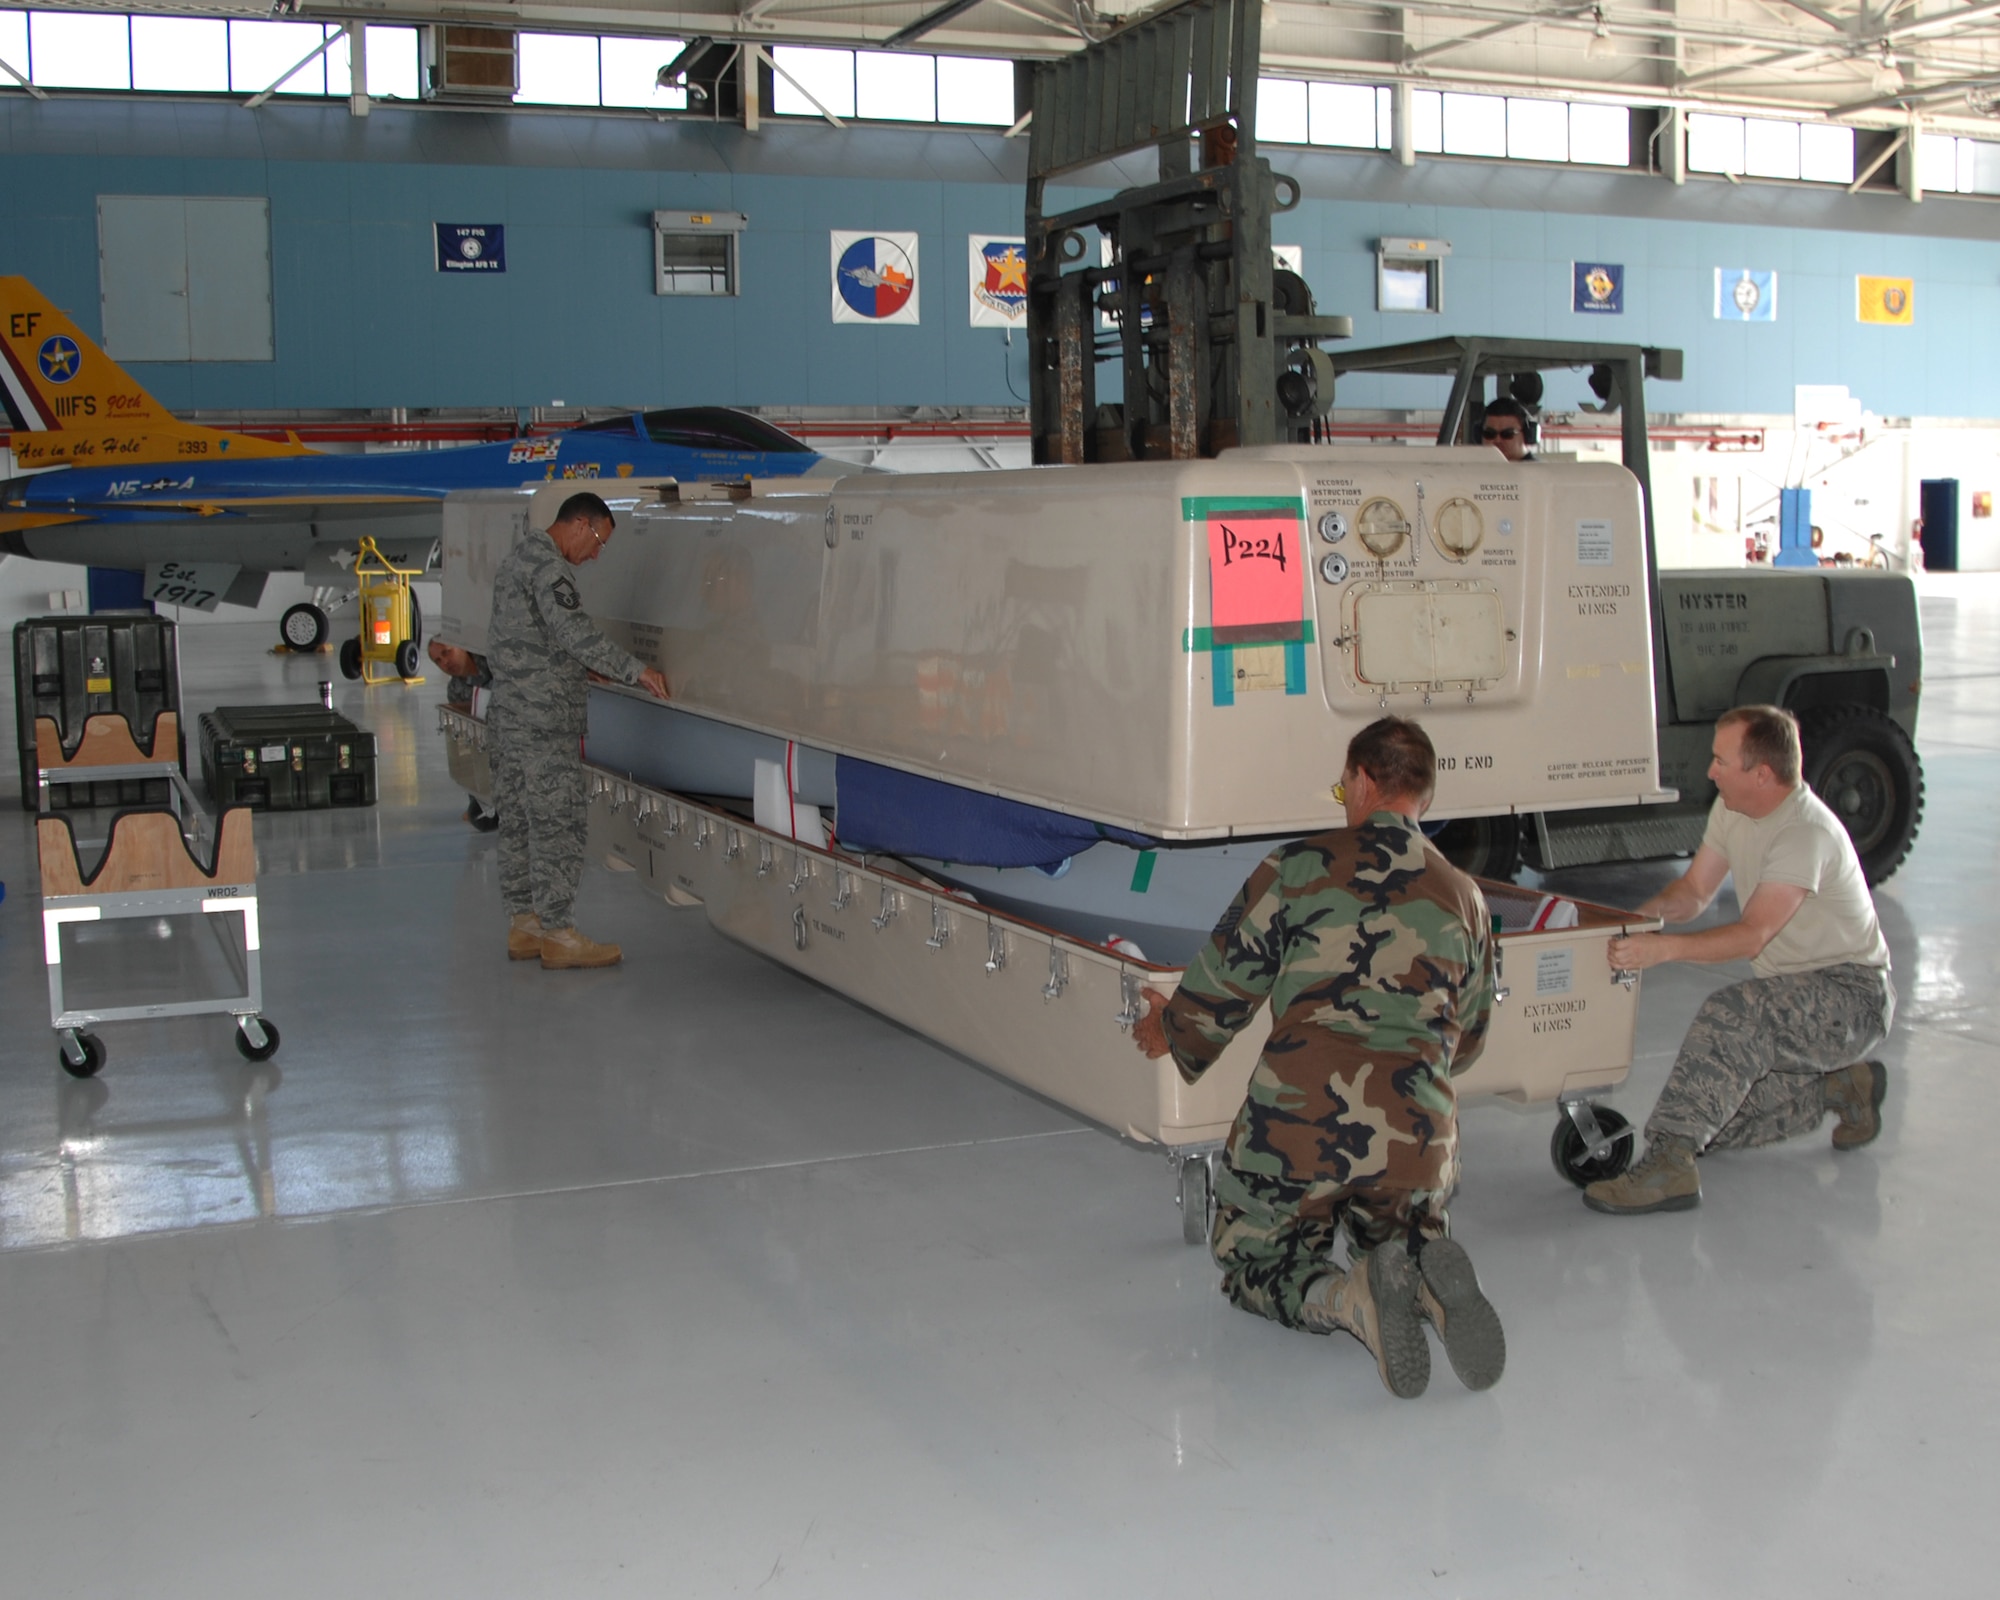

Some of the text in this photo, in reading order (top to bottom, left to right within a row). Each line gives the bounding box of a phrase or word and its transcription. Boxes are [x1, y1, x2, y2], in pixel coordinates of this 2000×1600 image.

[10, 312, 42, 337] EF
[106, 393, 142, 411] 90th
[51, 444, 65, 456] in
[73, 440, 95, 456] the
[185, 440, 208, 454] 393
[1220, 523, 1287, 573] P224
[159, 562, 197, 585] Est.
[1365, 570, 1379, 578] NOT
[153, 583, 216, 607] 1917
[1568, 584, 1631, 599] EXTENDED
[1679, 593, 1747, 610] HYSTER
[1465, 756, 1493, 770] END
[1582, 760, 1613, 769] RELEASE
[1615, 757, 1651, 767] PRESSURE
[1547, 772, 1575, 781] BEFORE
[1609, 767, 1646, 777] CONTAINER
[1524, 999, 1586, 1018] EXTENDED
